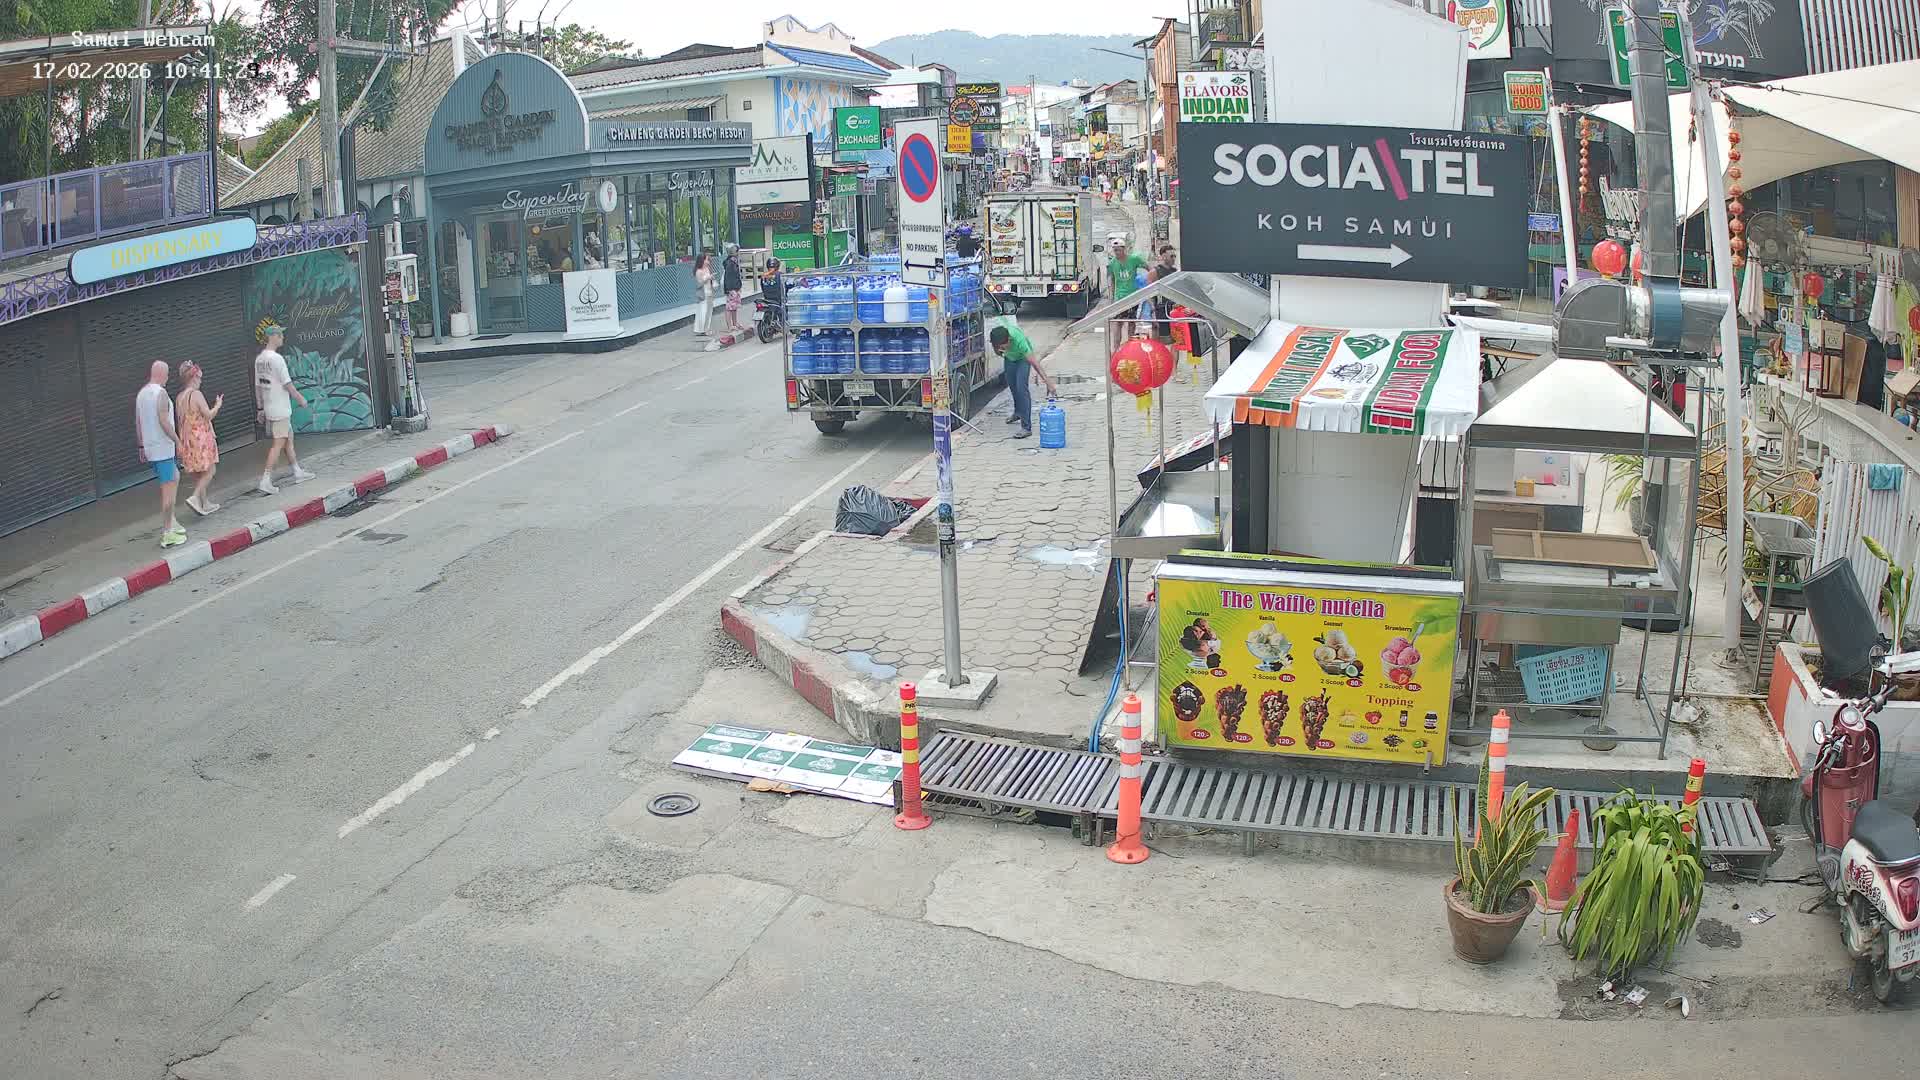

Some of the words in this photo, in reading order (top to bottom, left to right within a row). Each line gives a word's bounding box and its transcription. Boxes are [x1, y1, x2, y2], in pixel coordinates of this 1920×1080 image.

[1184, 85, 1248, 97] FLAVORS
[1509, 83, 1542, 96] INDIAN
[1183, 97, 1249, 114] INDIAN
[1512, 96, 1542, 109] FOOD
[611, 128, 655, 140] CHAWENG
[657, 127, 691, 139] GARDEN
[693, 127, 717, 139] BEACH
[720, 127, 746, 139] RESORT
[838, 134, 879, 145] EXCHANGE
[668, 170, 714, 200] SuperJay
[502, 183, 590, 221] SuperJay
[528, 208, 551, 217] GREEN
[551, 205, 582, 215] GROCER
[1257, 213, 1323, 233] KOH
[1344, 217, 1451, 238] SAMUI
[111, 229, 223, 270] DISPENSARY
[773, 240, 811, 250] EXCHANGE
[906, 243, 914, 252] NO
[914, 243, 939, 253] PARKING
[289, 293, 350, 331] Pineapple
[298, 328, 345, 342] THAILAND
[1221, 590, 1253, 608] The
[1259, 592, 1316, 613] Waffle
[1321, 598, 1385, 618] nutella
[1384, 624, 1412, 633] Strawberry
[1366, 694, 1414, 708] Topping
[1902, 949, 1915, 962] 37
